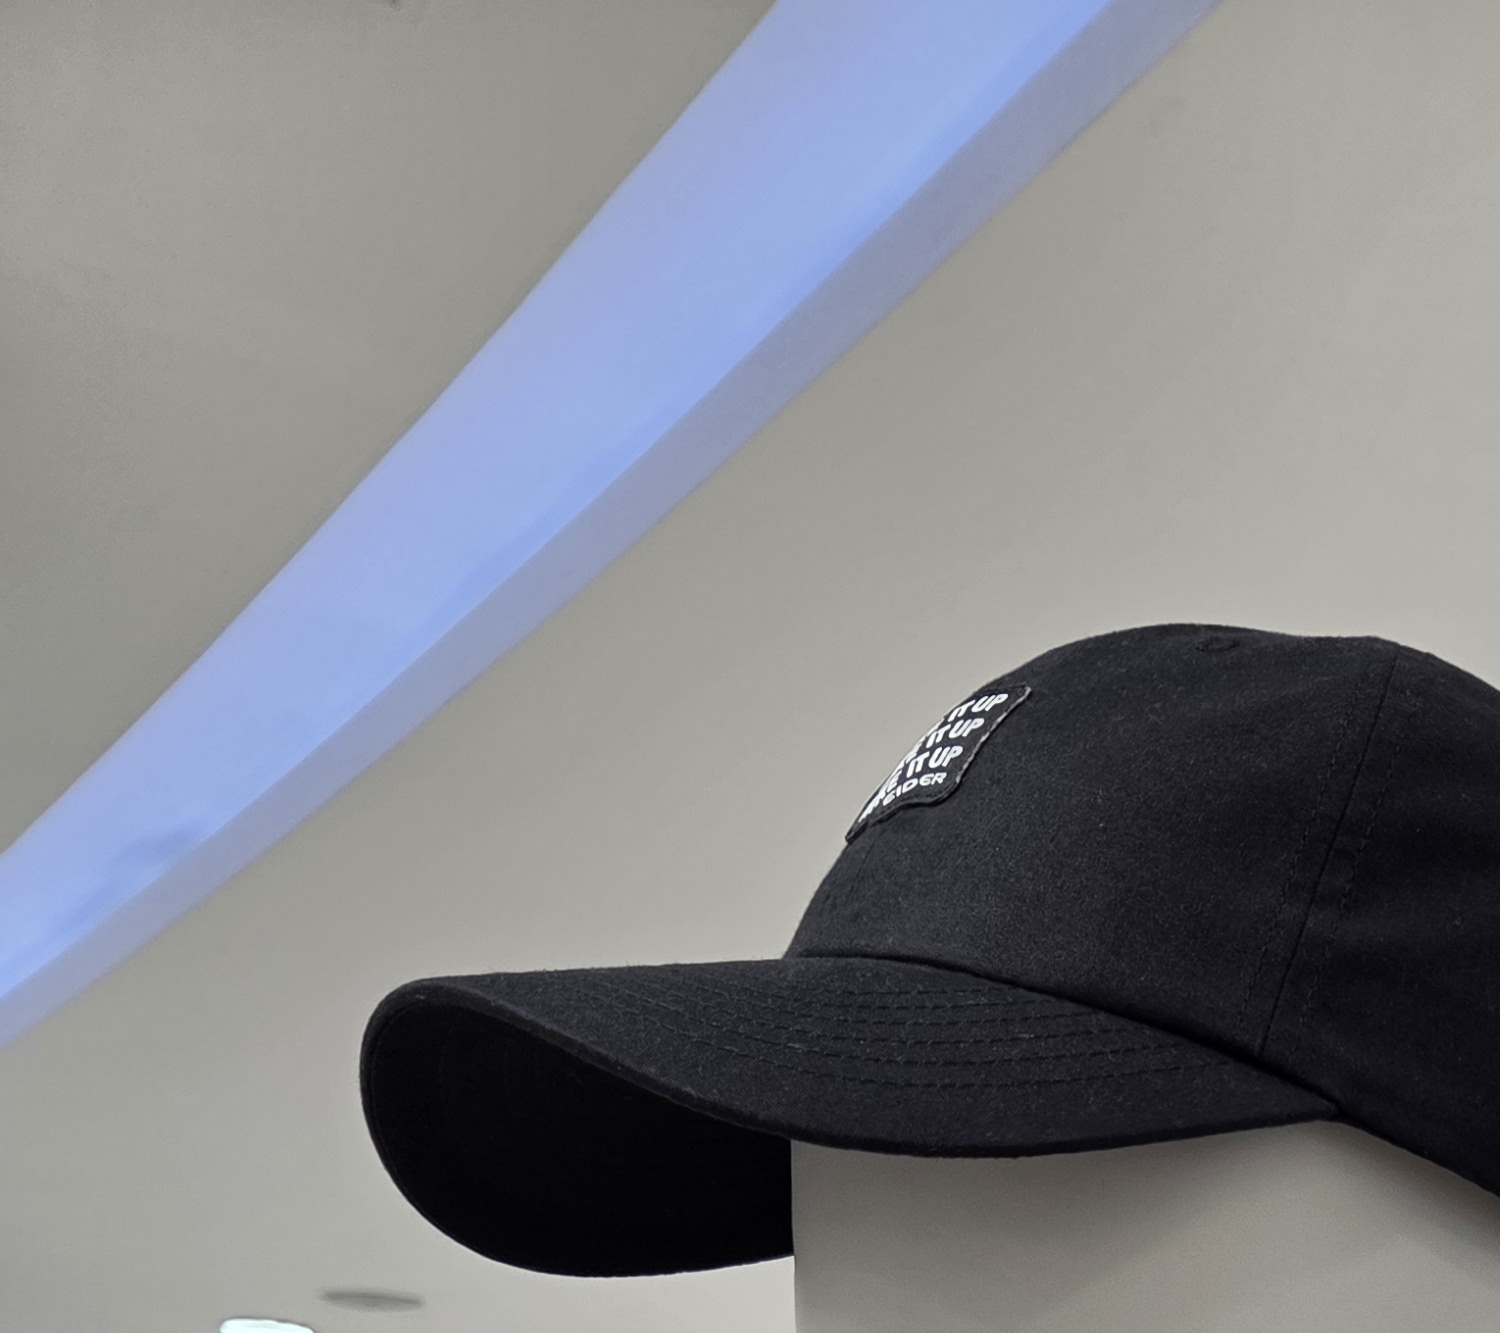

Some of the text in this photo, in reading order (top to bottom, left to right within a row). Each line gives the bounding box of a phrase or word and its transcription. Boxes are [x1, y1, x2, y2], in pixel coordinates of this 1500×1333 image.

[947, 693, 1008, 722] IT UP
[926, 717, 985, 749] IT UP
[906, 751, 930, 778] IT
[928, 745, 963, 769] UP
[882, 772, 948, 806] EIDER
